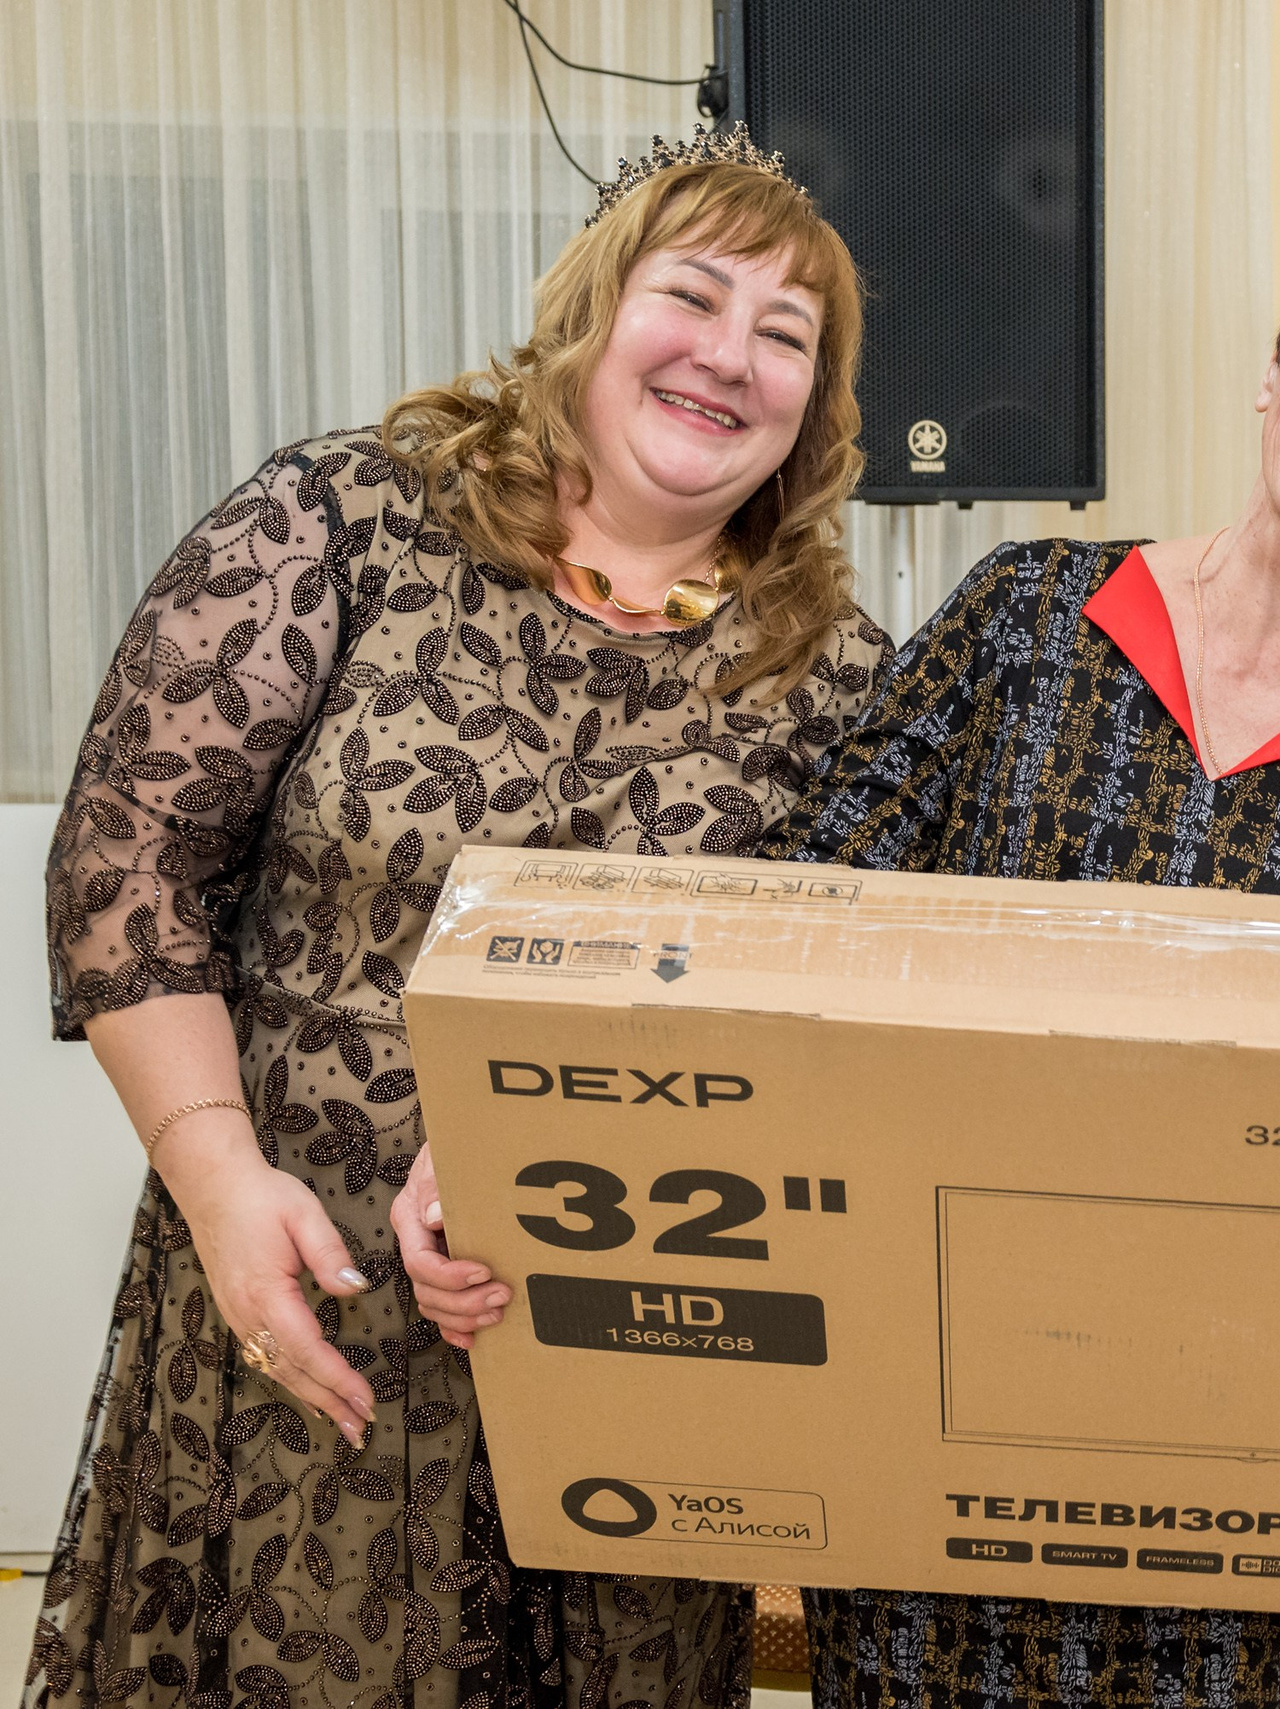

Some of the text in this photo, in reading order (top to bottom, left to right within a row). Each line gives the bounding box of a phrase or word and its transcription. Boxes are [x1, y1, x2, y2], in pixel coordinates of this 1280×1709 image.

[487, 1059, 754, 1108] DEXP
[514, 1159, 848, 1262] 32"
[630, 1290, 725, 1327] HD
[667, 1493, 744, 1515] YaOS
[671, 1516, 811, 1540] с Алисой
[971, 1543, 1008, 1557] HD
[1052, 1550, 1117, 1561] SMART TV
[1145, 1556, 1215, 1567] FRAMELESS
